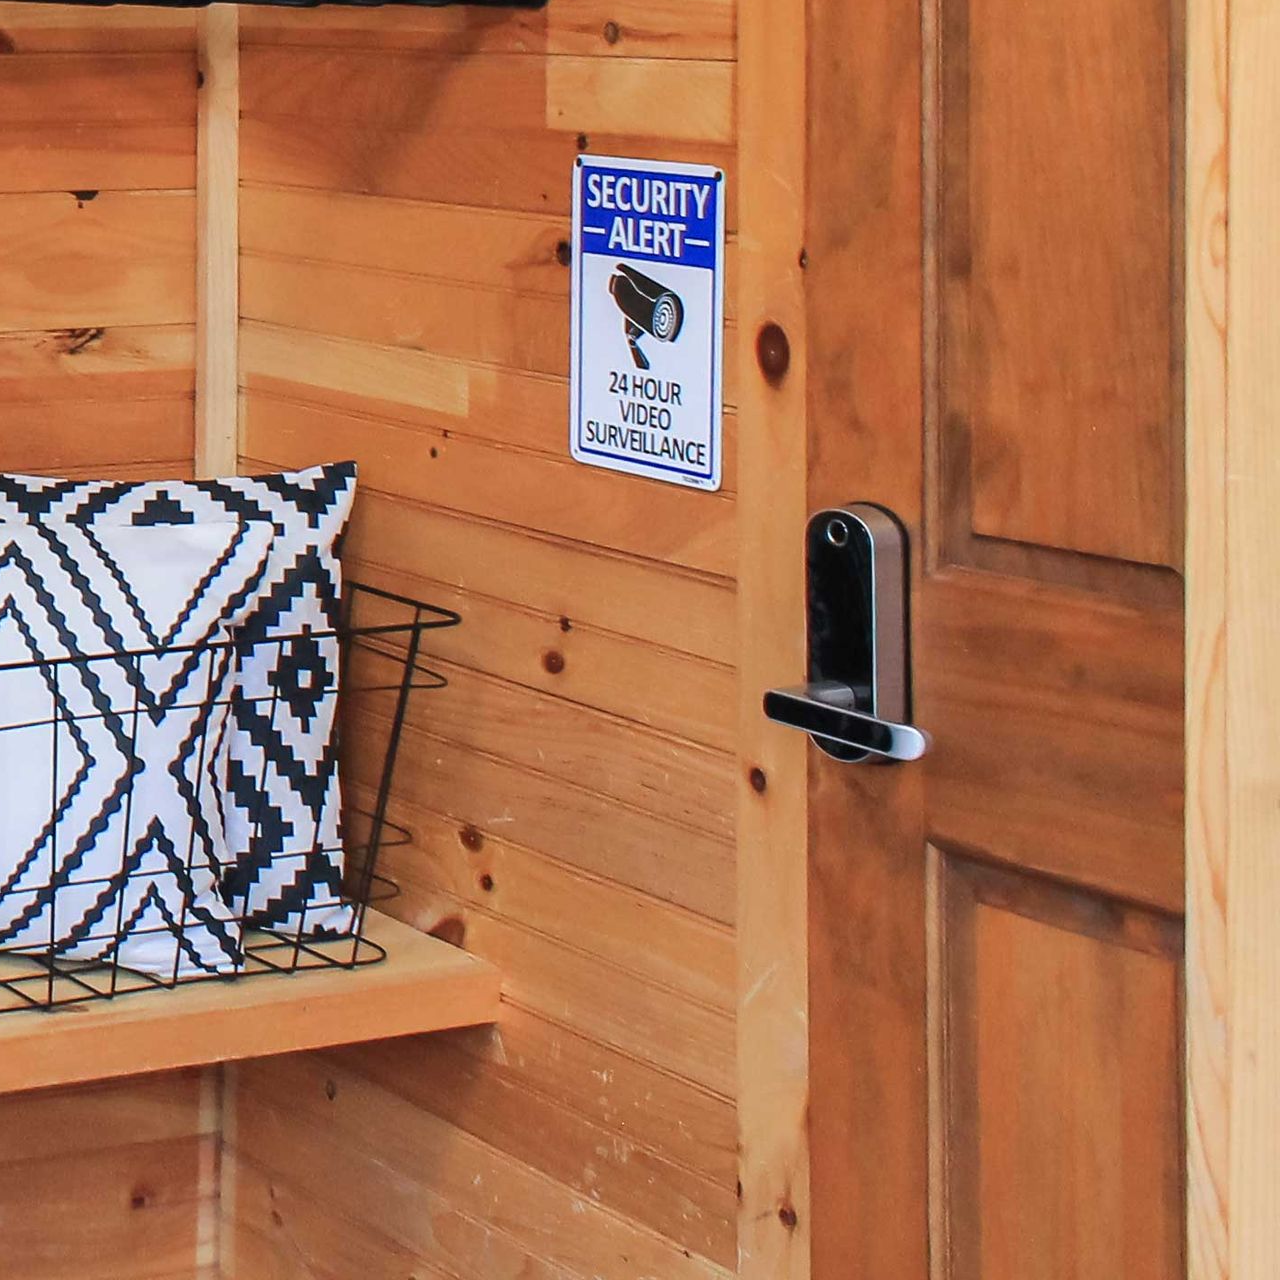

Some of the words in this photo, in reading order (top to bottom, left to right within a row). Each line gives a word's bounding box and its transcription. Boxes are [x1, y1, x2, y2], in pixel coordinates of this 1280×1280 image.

[587, 174, 710, 219] SECURITY
[609, 216, 686, 258] ALERT
[608, 371, 629, 396] 24
[632, 375, 683, 407] HOUR
[618, 399, 672, 431] VIDEO
[585, 420, 707, 467] SURVEILLANCE
